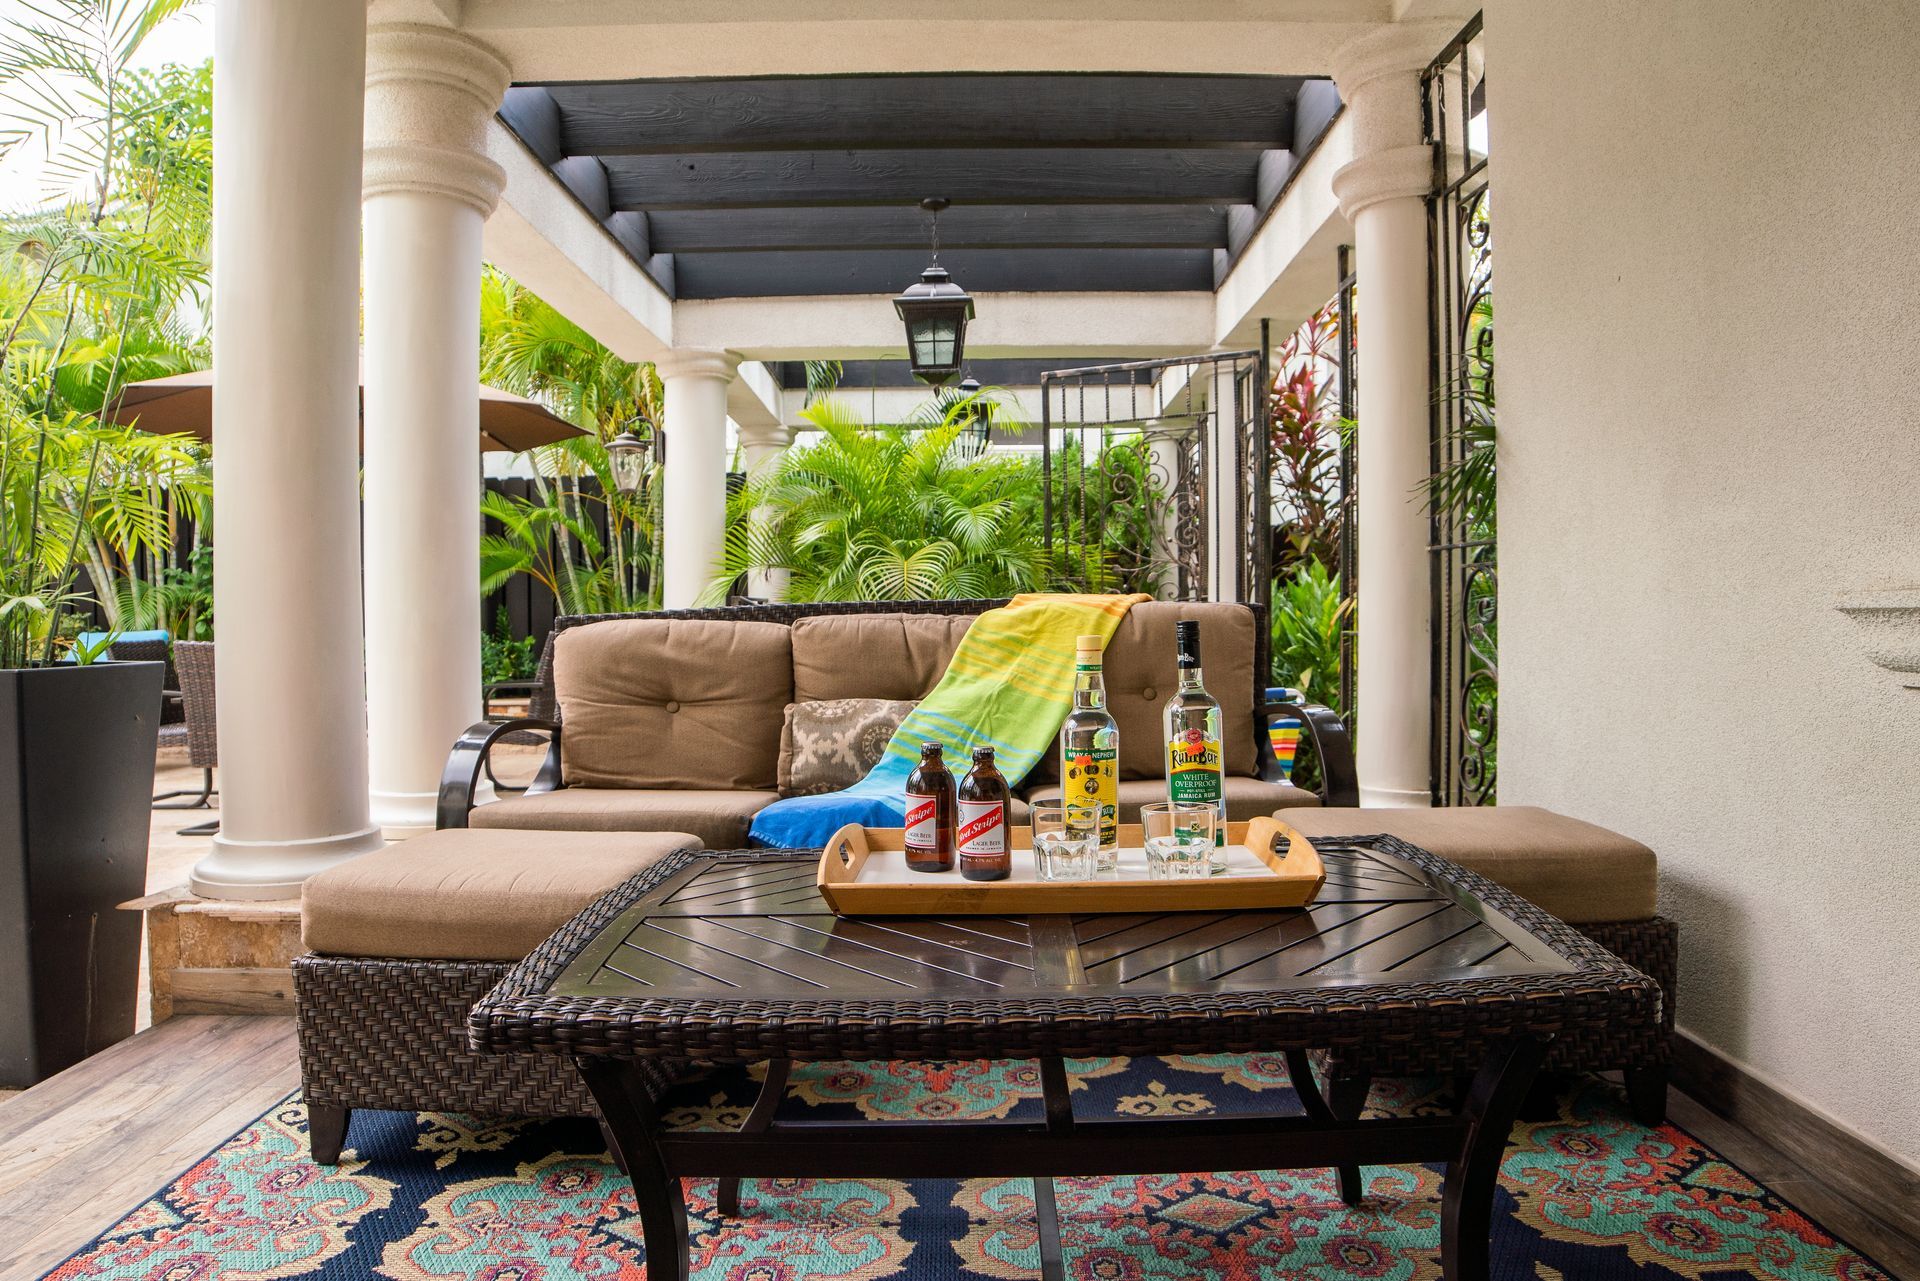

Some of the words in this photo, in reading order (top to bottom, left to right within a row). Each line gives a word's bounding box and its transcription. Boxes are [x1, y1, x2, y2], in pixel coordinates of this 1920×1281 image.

[1092, 751, 1115, 759] NEPHEW
[1182, 773, 1209, 781] WHITE
[1175, 780, 1217, 788] OVERPROOF
[908, 806, 933, 825] Stripe
[971, 812, 1001, 835] Stripe
